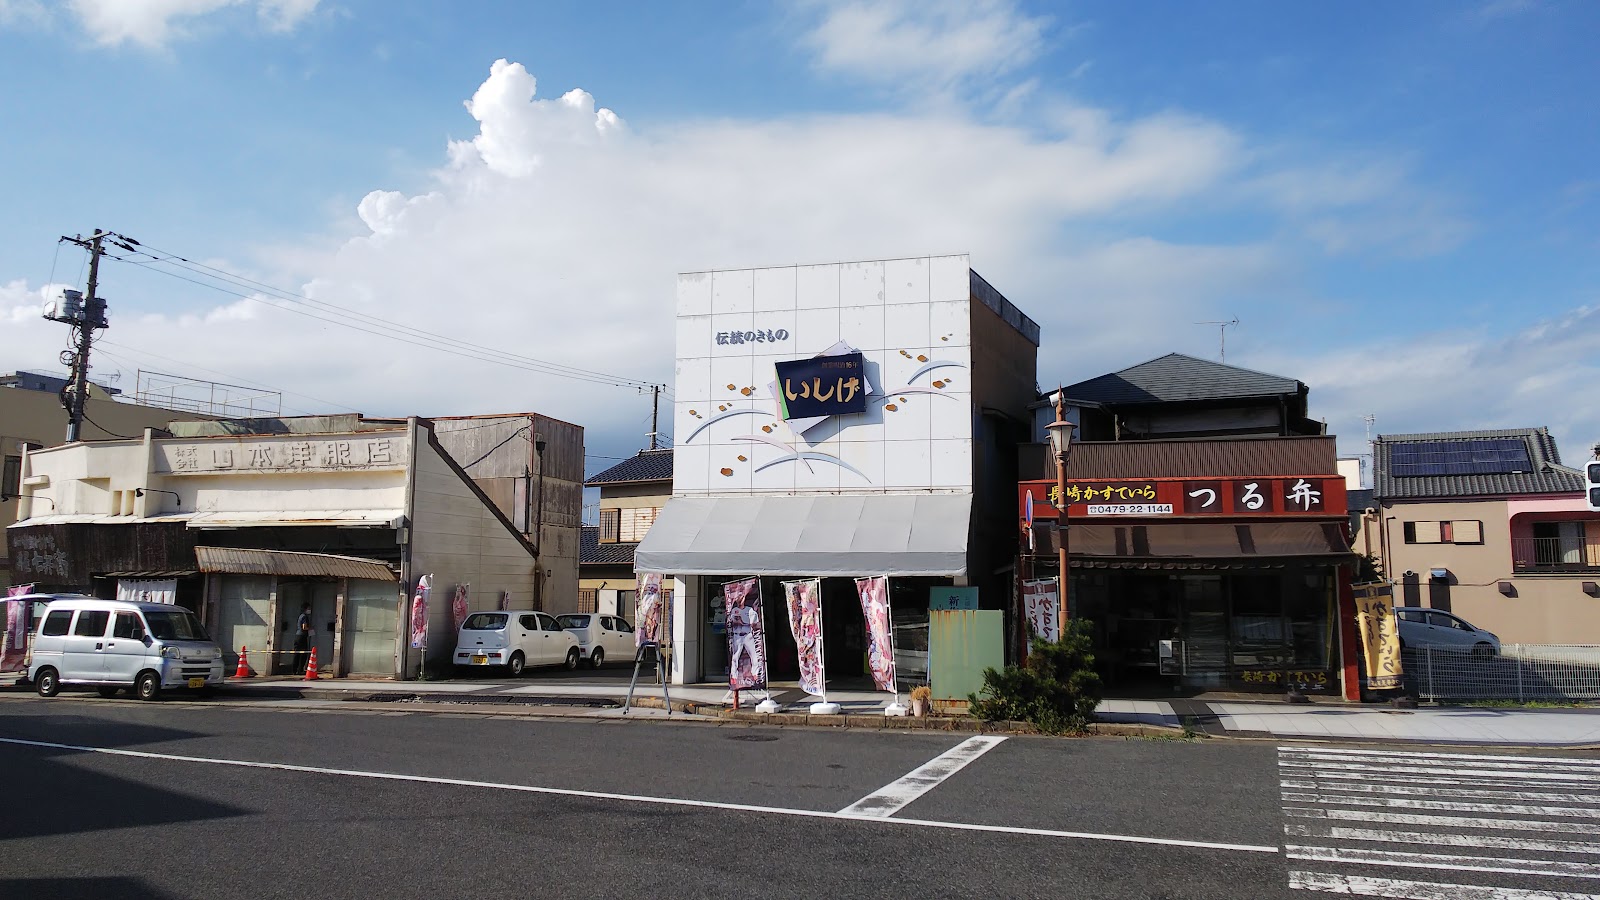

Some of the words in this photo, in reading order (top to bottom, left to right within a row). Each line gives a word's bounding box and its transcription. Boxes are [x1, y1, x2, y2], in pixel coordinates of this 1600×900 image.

[715, 328, 789, 345] 伝統のきもの
[785, 377, 860, 403] いしげ
[213, 440, 391, 468] 山本洋服店
[1047, 484, 1156, 502] 長崎かすていら
[1189, 478, 1321, 511] つる弁
